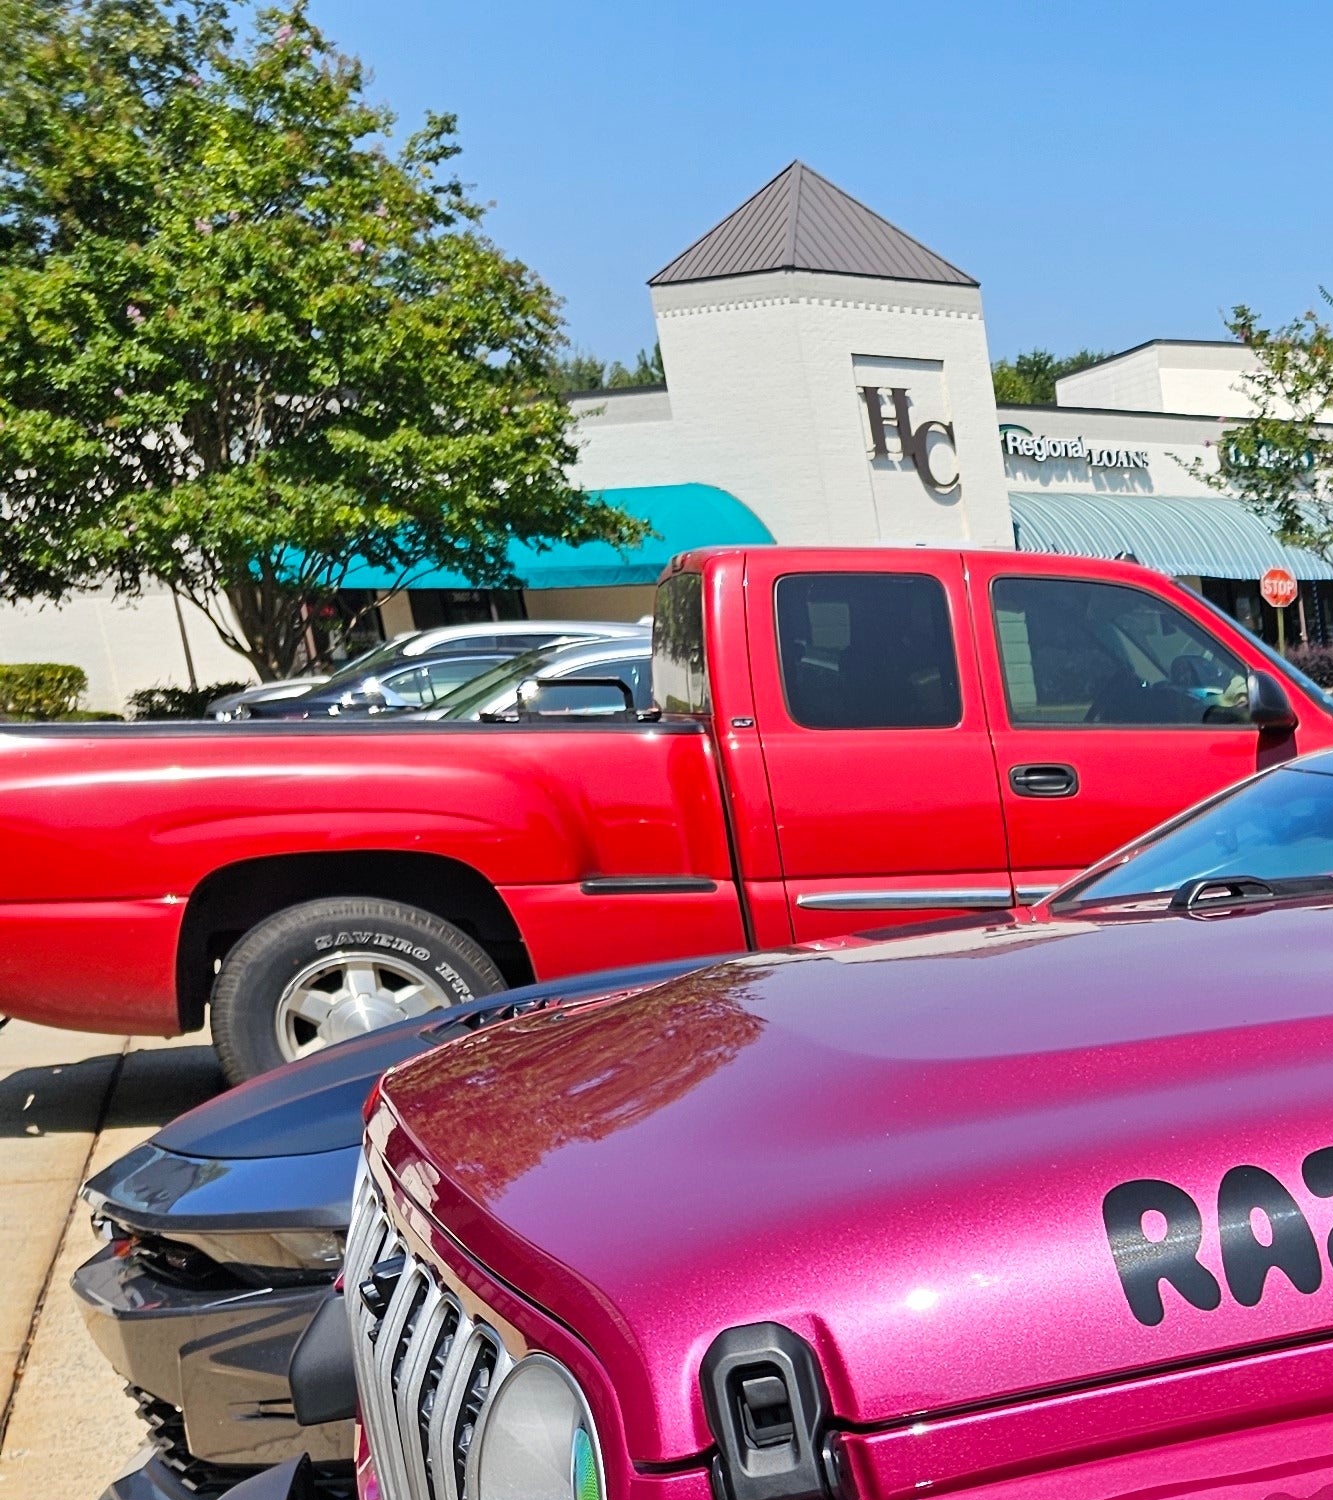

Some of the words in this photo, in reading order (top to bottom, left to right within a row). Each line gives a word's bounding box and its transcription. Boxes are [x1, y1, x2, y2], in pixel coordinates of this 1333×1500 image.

[1006, 432, 1087, 462] Regional
[1089, 449, 1149, 468] LOANS
[1264, 579, 1295, 596] STOP
[314, 931, 431, 962] SAVERO
